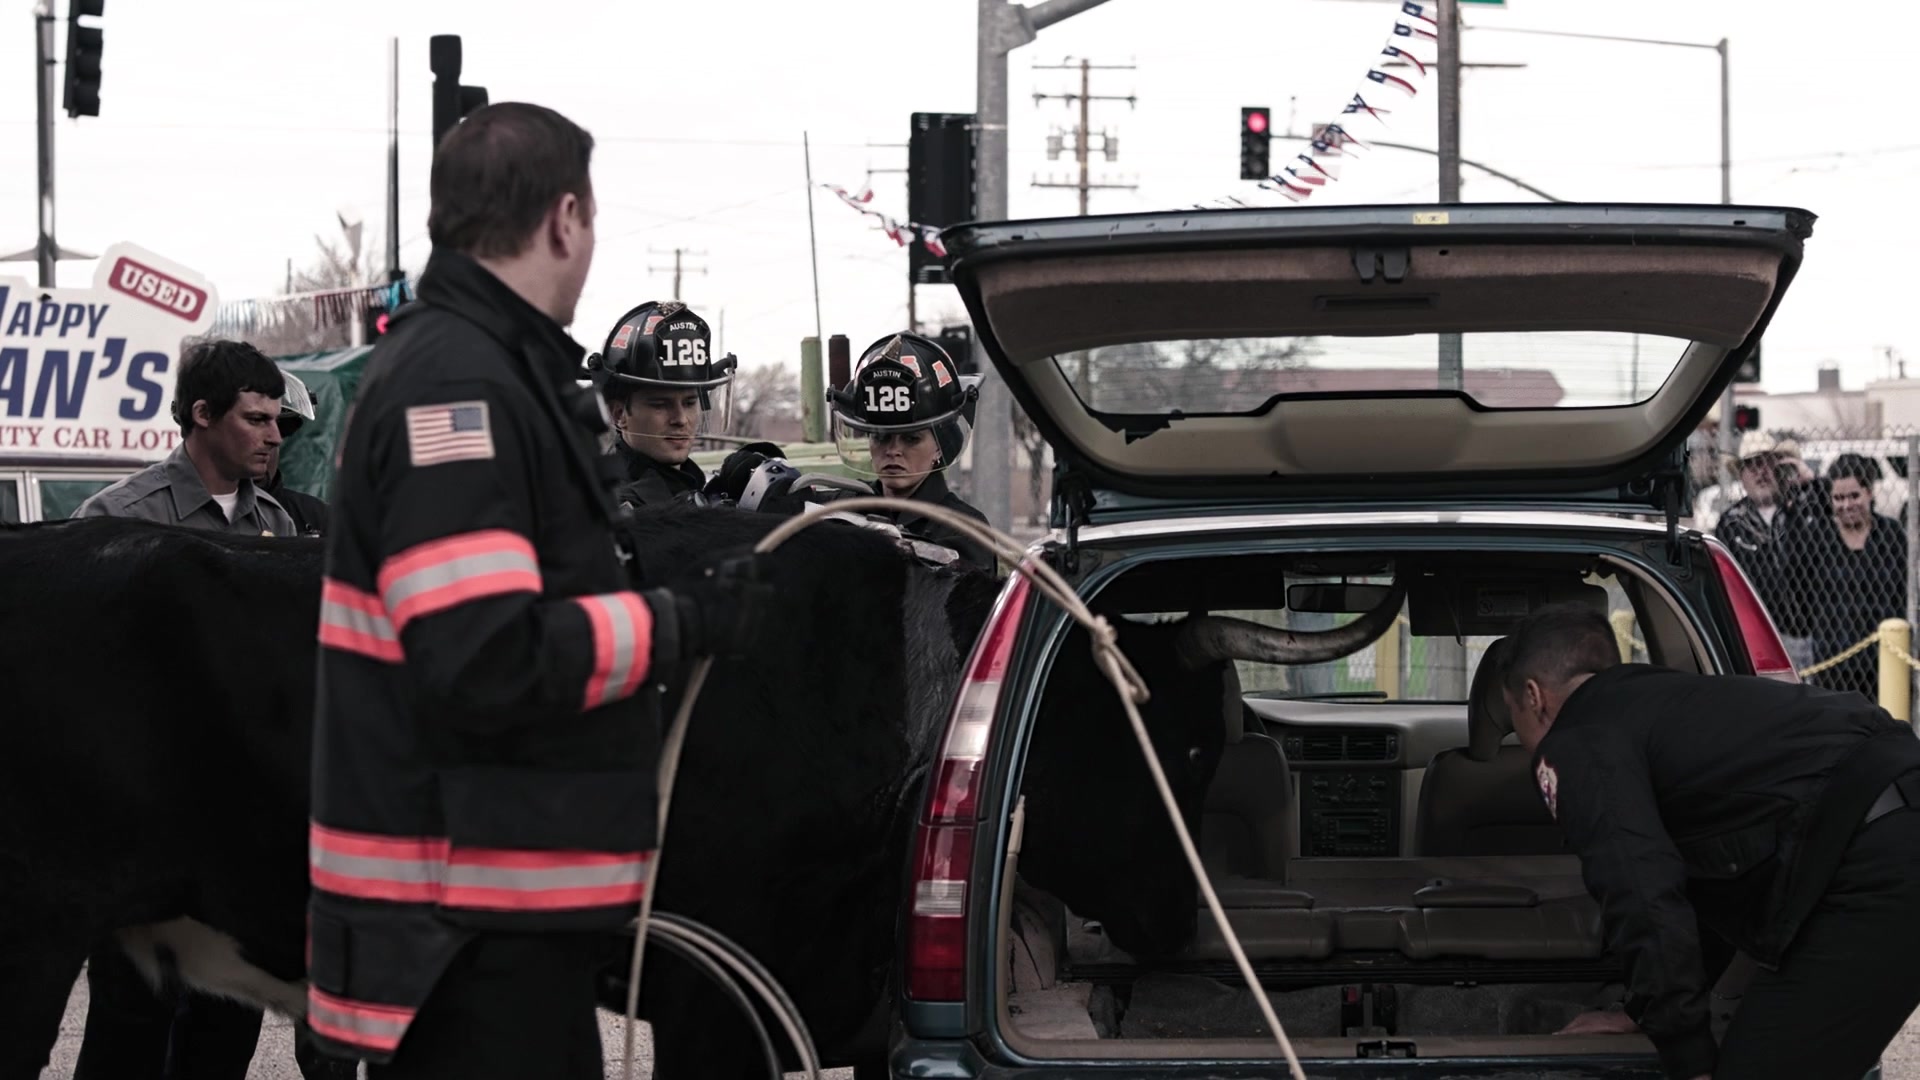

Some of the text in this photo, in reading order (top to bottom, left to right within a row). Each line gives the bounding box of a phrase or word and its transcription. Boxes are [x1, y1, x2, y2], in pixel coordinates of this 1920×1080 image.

[119, 263, 198, 314] USED
[669, 322, 698, 332] AUSTIN
[662, 338, 706, 366] 126
[873, 370, 902, 379] AUSTIN
[864, 385, 911, 412] 126
[53, 427, 112, 449] CAR
[121, 428, 179, 450] LOT
